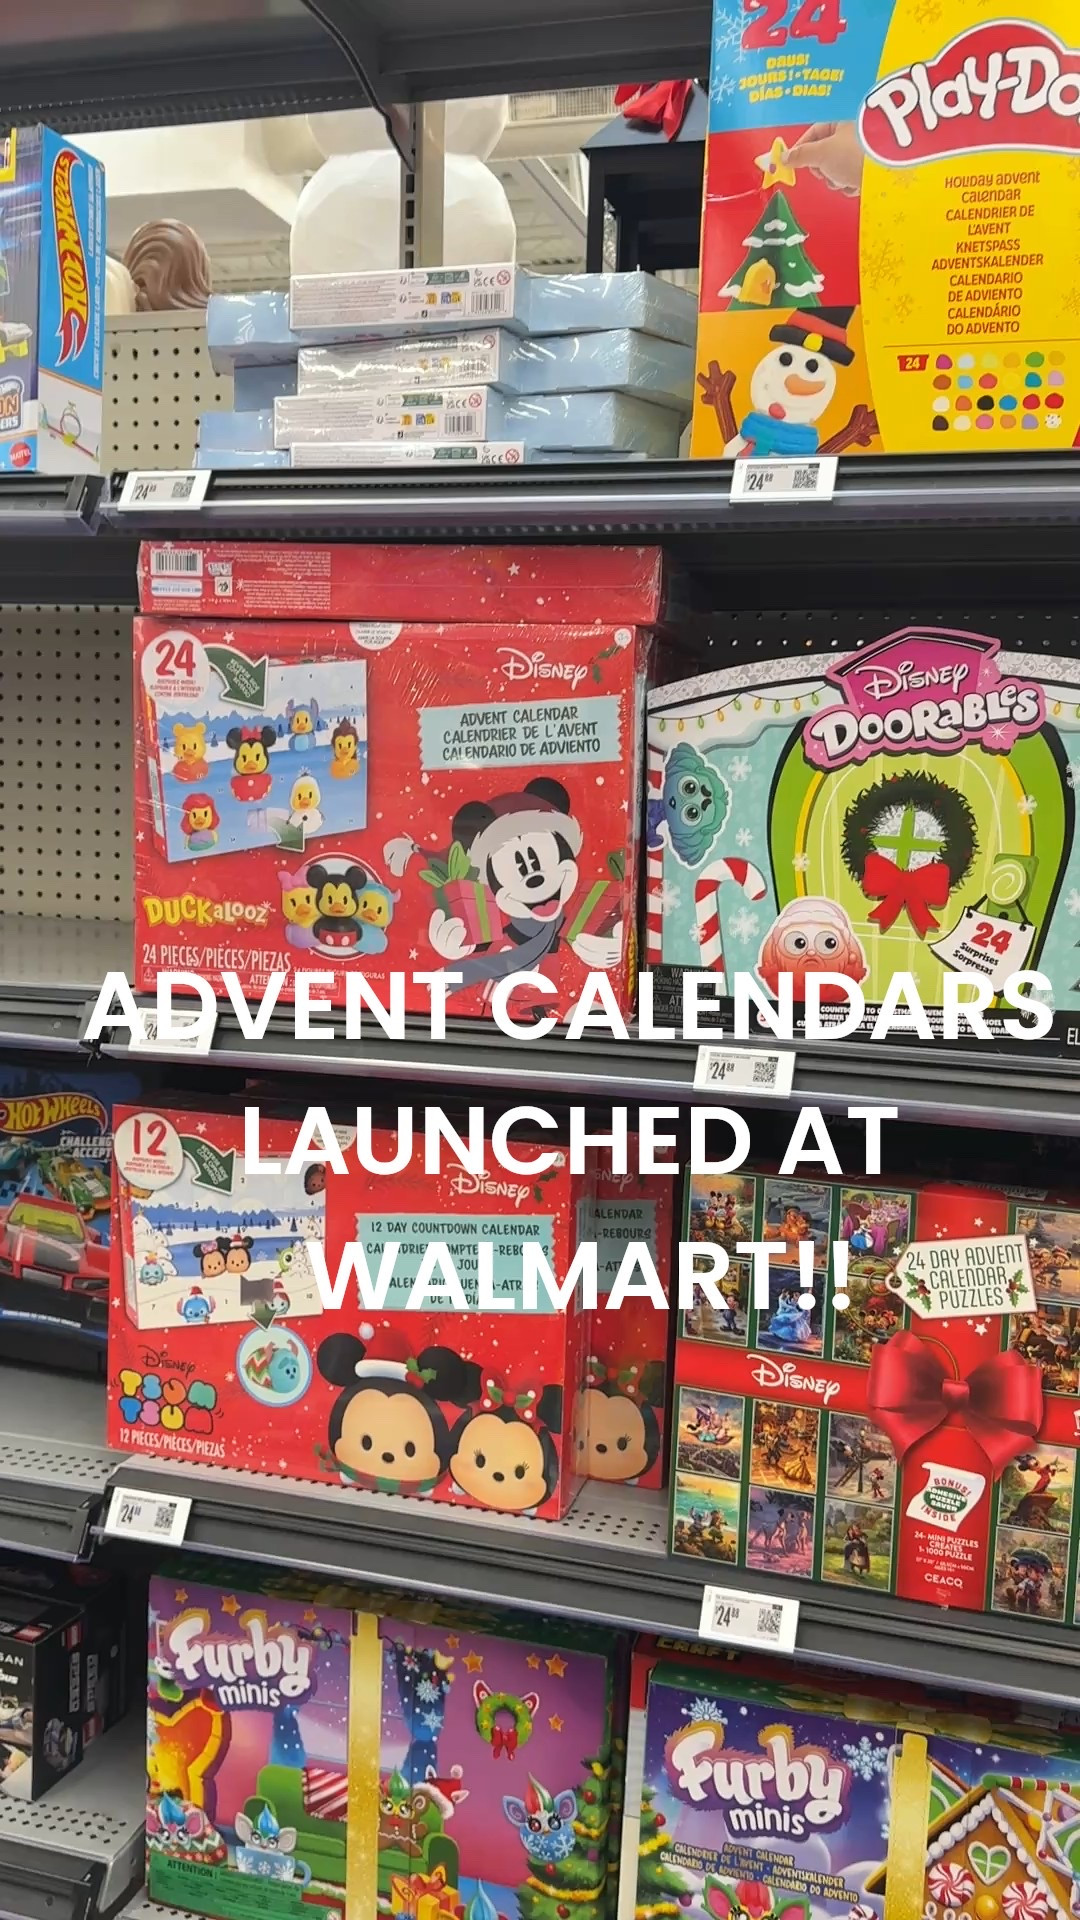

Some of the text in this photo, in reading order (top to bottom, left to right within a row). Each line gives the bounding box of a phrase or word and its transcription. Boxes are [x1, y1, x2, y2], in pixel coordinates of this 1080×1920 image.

[741, 0, 848, 50] 24
[866, 45, 1080, 148] Play-Do
[946, 204, 1035, 221] CALENDRIER DE
[968, 222, 1011, 236] L'AVENT
[956, 238, 1021, 254] KNETSPASS
[931, 253, 1044, 270] ADVENTSKALENDER
[949, 272, 1023, 286] CALENDARIO
[948, 287, 1023, 302] DE ADVIENTO
[948, 303, 1021, 319] CALENDÁRIO
[947, 321, 1020, 335] DO ADVENTO
[905, 357, 920, 369] 24
[155, 639, 196, 678] 24
[460, 706, 579, 727] ADVENT CALENDAR
[443, 722, 599, 745] CALENDRIER DE L'AVENT
[442, 738, 601, 762] CALENDARIO DE ADVIENTO
[971, 922, 1013, 955] 24
[143, 944, 157, 964] 24
[953, 949, 994, 976] Sorpresas
[960, 942, 999, 966] Surprises
[60, 1136, 113, 1147] CHALLENG
[134, 1119, 166, 1157] 12
[72, 1148, 111, 1158] ACCEPT
[595, 1208, 643, 1219] ALENDAR
[371, 1221, 540, 1236] 12 DAY COUNTDOWN CALENDAR
[907, 1244, 1023, 1270] 24 DAY ADVENT
[929, 1266, 1008, 1289] CALENDAR
[940, 1287, 1004, 1309] PUZZLES
[120, 1428, 129, 1443] 12
[934, 1478, 972, 1497] BONUS!
[930, 1494, 961, 1507] PUZZLE
[930, 1500, 958, 1513] SAVER
[921, 1504, 957, 1522] INSIDE
[928, 1533, 946, 1542] MINI
[947, 1536, 979, 1549] PUZZLES
[929, 1541, 963, 1553] CREATES
[926, 1547, 944, 1557] 1000
[945, 1550, 973, 1562] PUZZLE
[169, 1615, 311, 1696] Furby
[217, 1680, 281, 1707] minis
[672, 1728, 843, 1824] Furby
[729, 1802, 805, 1835] minis
[723, 1843, 794, 1866] ADVENT CALENDAR
[167, 1859, 213, 1878] ATTENTION
[674, 1843, 718, 1862] CALENDRIER
[721, 1854, 731, 1865] DE
[772, 1865, 845, 1888] ADVENTSKALENDER
[660, 1851, 703, 1870] CALENDARIO
[705, 1862, 716, 1873] DE
[719, 1866, 754, 1881] ADVIENTO
[810, 1884, 821, 1895] DO
[823, 1888, 860, 1903] ADVENTO
